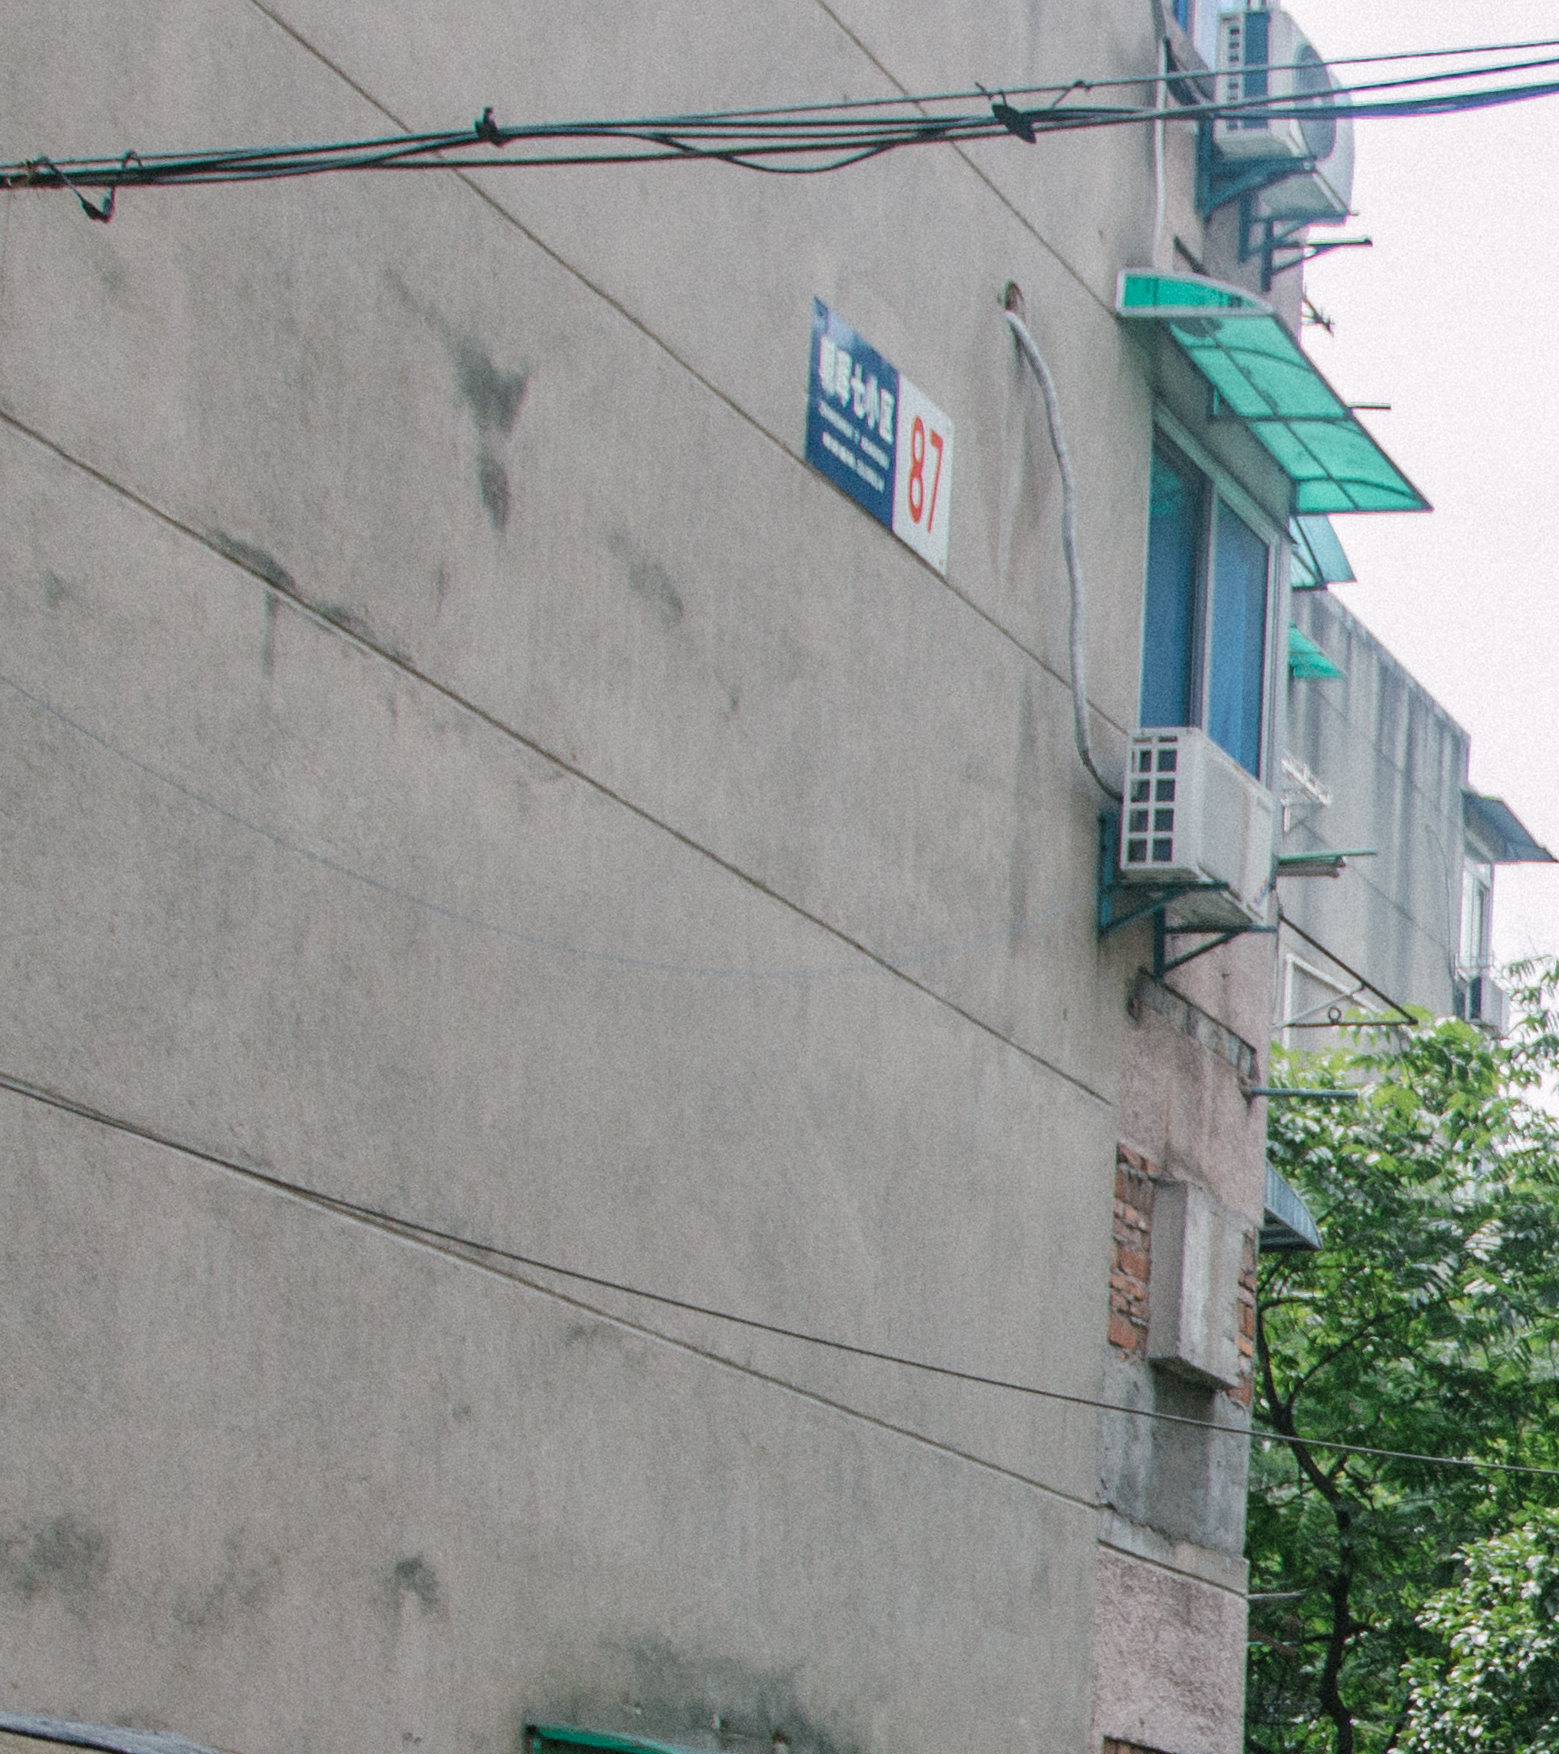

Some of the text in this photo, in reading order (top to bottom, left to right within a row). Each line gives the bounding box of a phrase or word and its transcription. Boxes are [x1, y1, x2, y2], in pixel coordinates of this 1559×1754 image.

[819, 333, 896, 445] 七小区
[907, 415, 945, 535] 87
